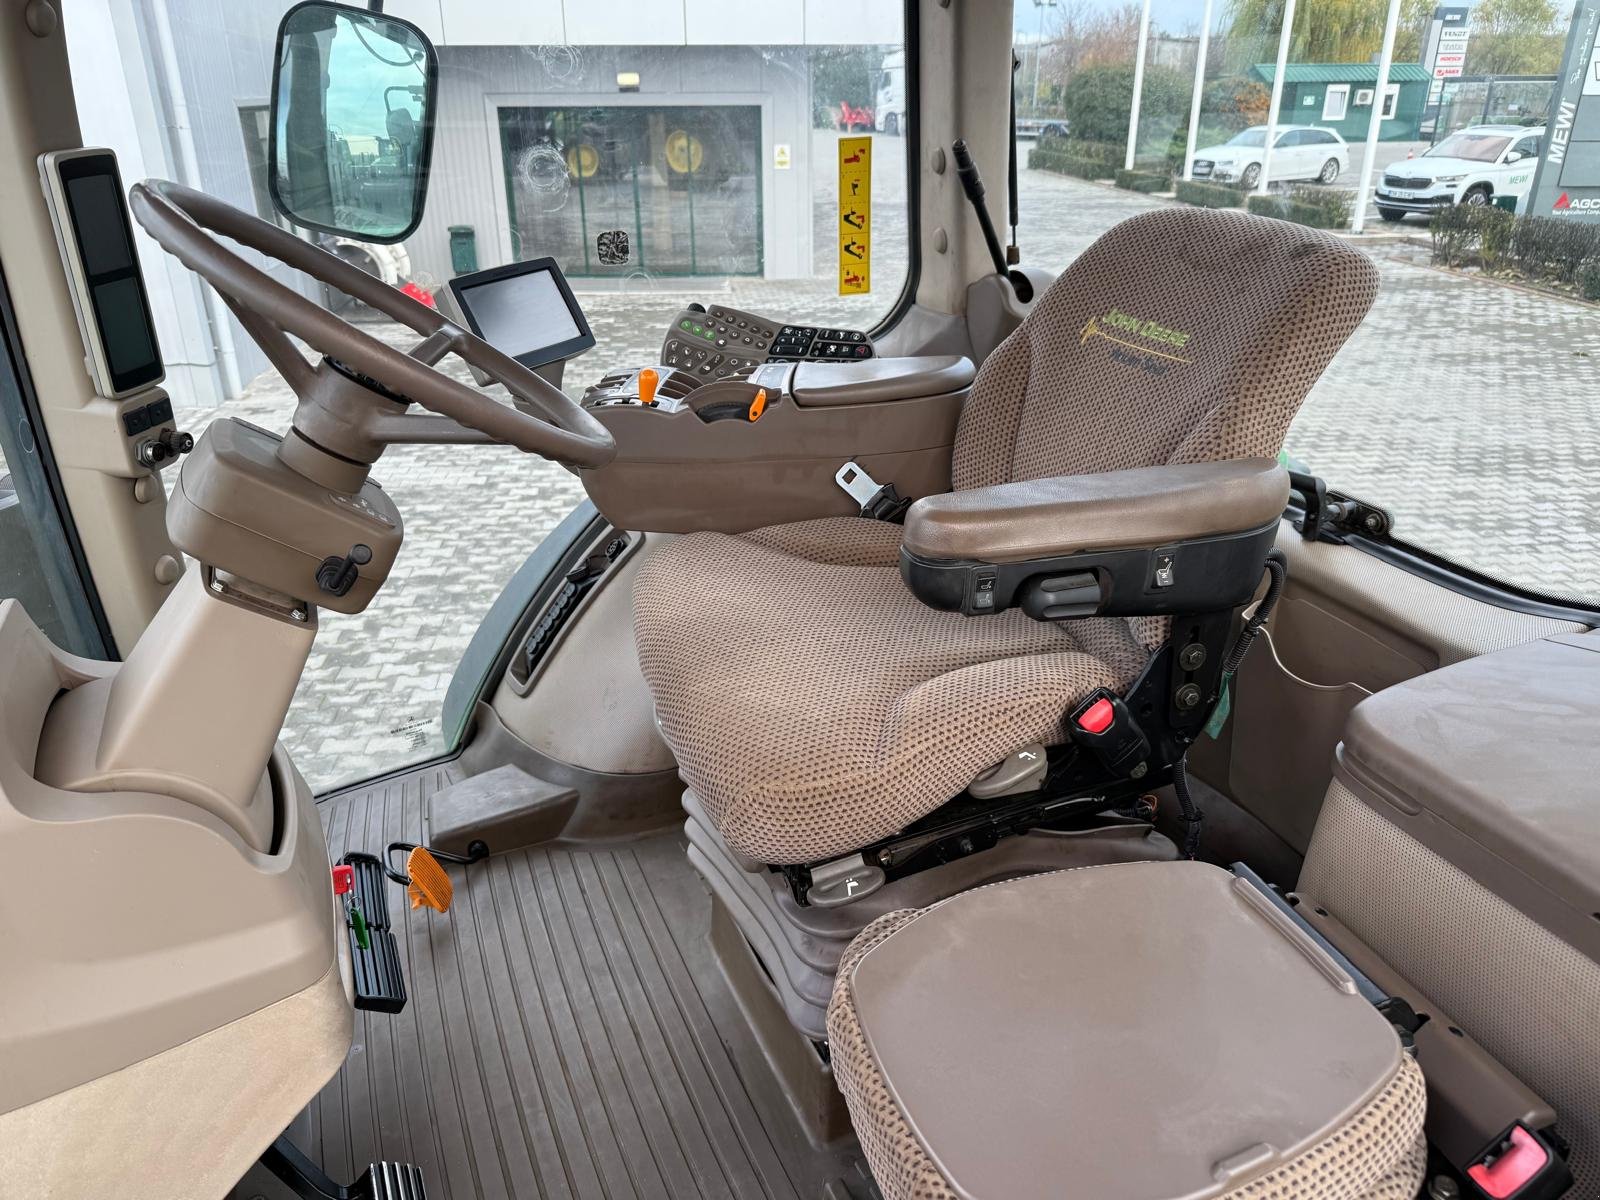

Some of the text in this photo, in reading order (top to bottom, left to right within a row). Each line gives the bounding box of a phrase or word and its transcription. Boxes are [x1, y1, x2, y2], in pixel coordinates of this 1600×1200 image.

[1548, 101, 1576, 163] MEWI
[1102, 308, 1190, 347] JOHN DEERE
